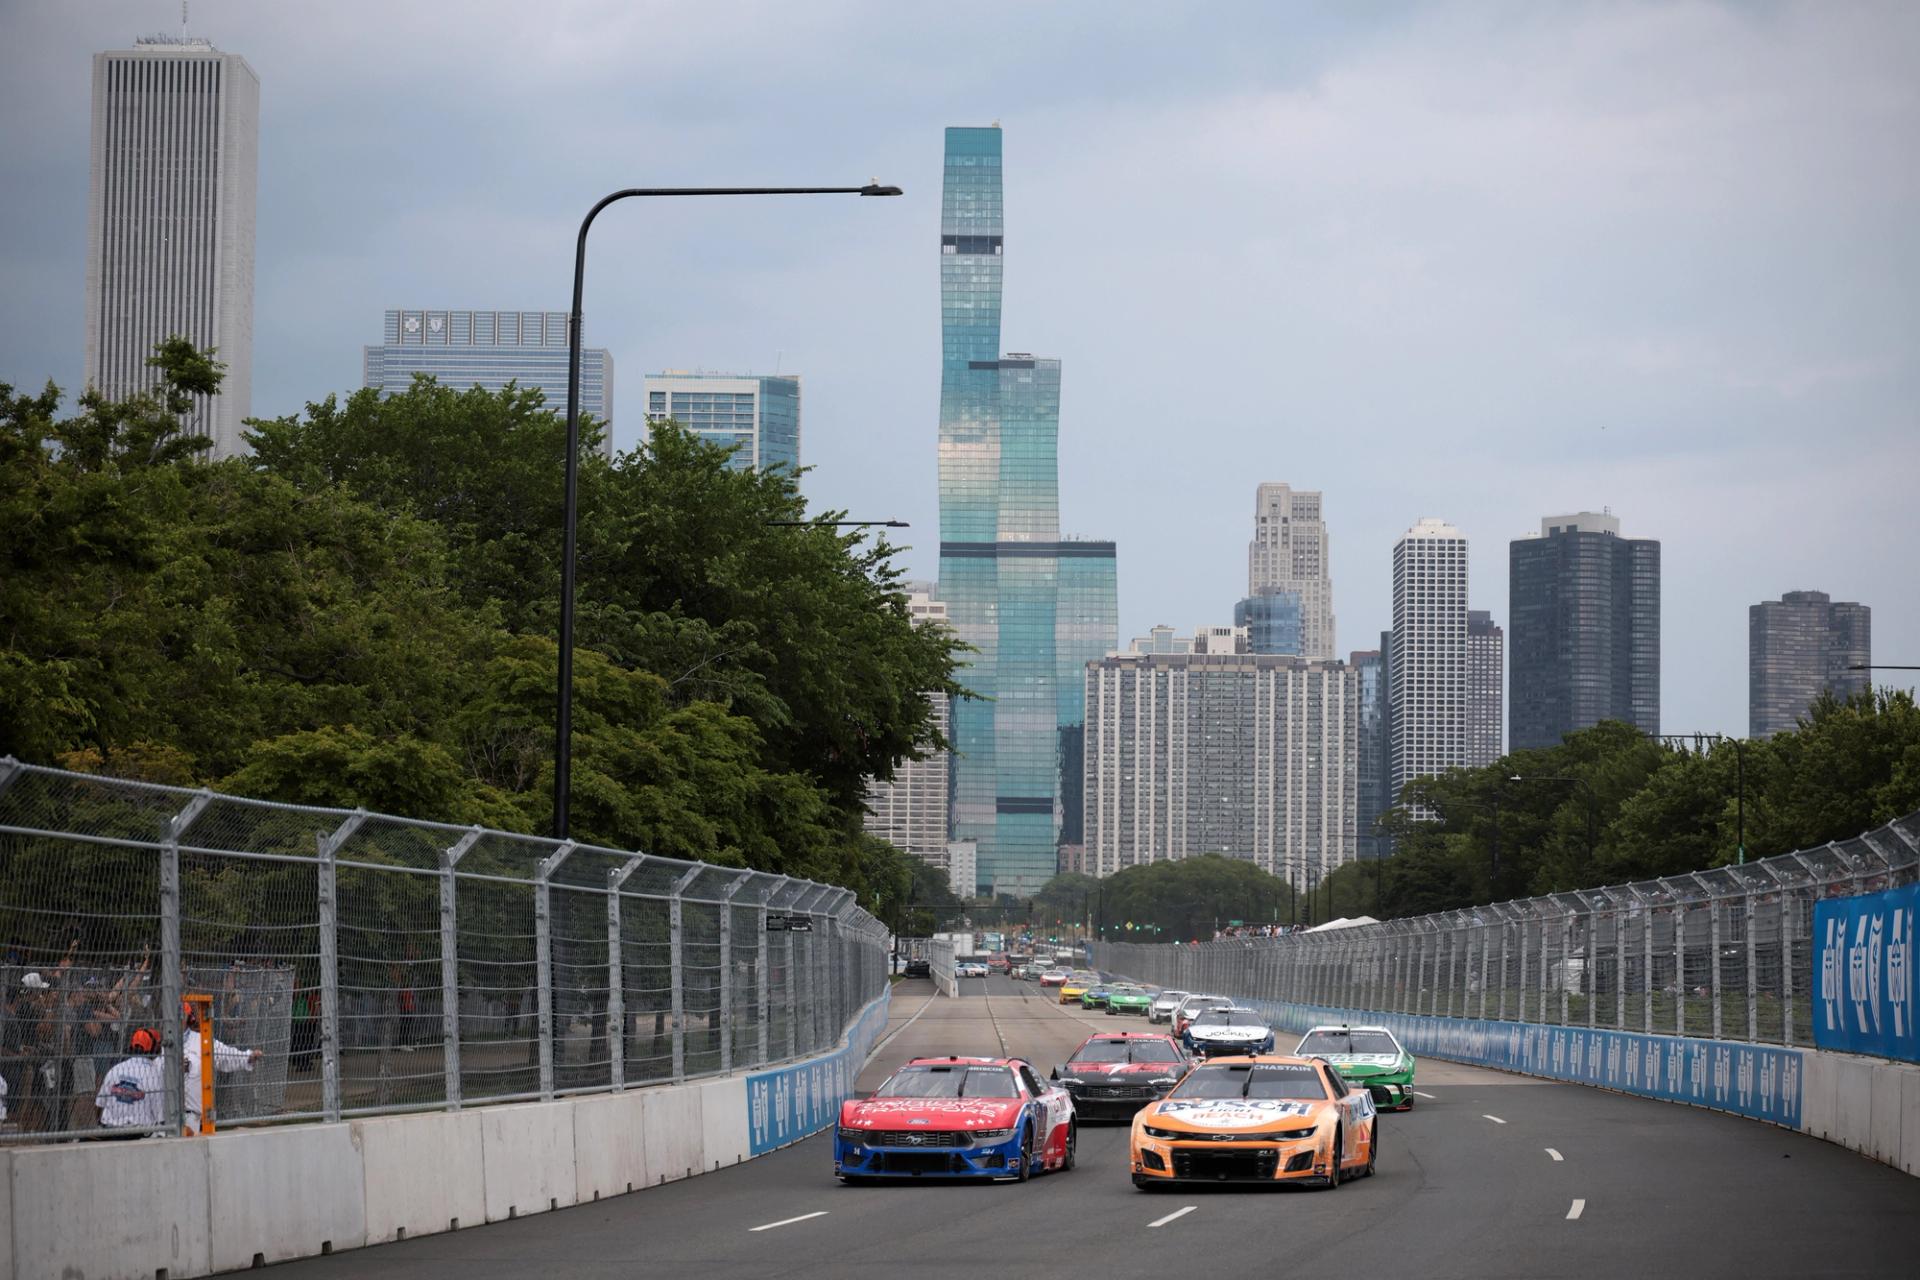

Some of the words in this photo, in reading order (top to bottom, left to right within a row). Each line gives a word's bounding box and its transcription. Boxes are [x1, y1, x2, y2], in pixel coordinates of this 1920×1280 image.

[1254, 1064, 1312, 1072] CHASTAIN
[856, 1105, 996, 1118] TRACTORS
[1157, 1099, 1313, 1117] BUSCH
